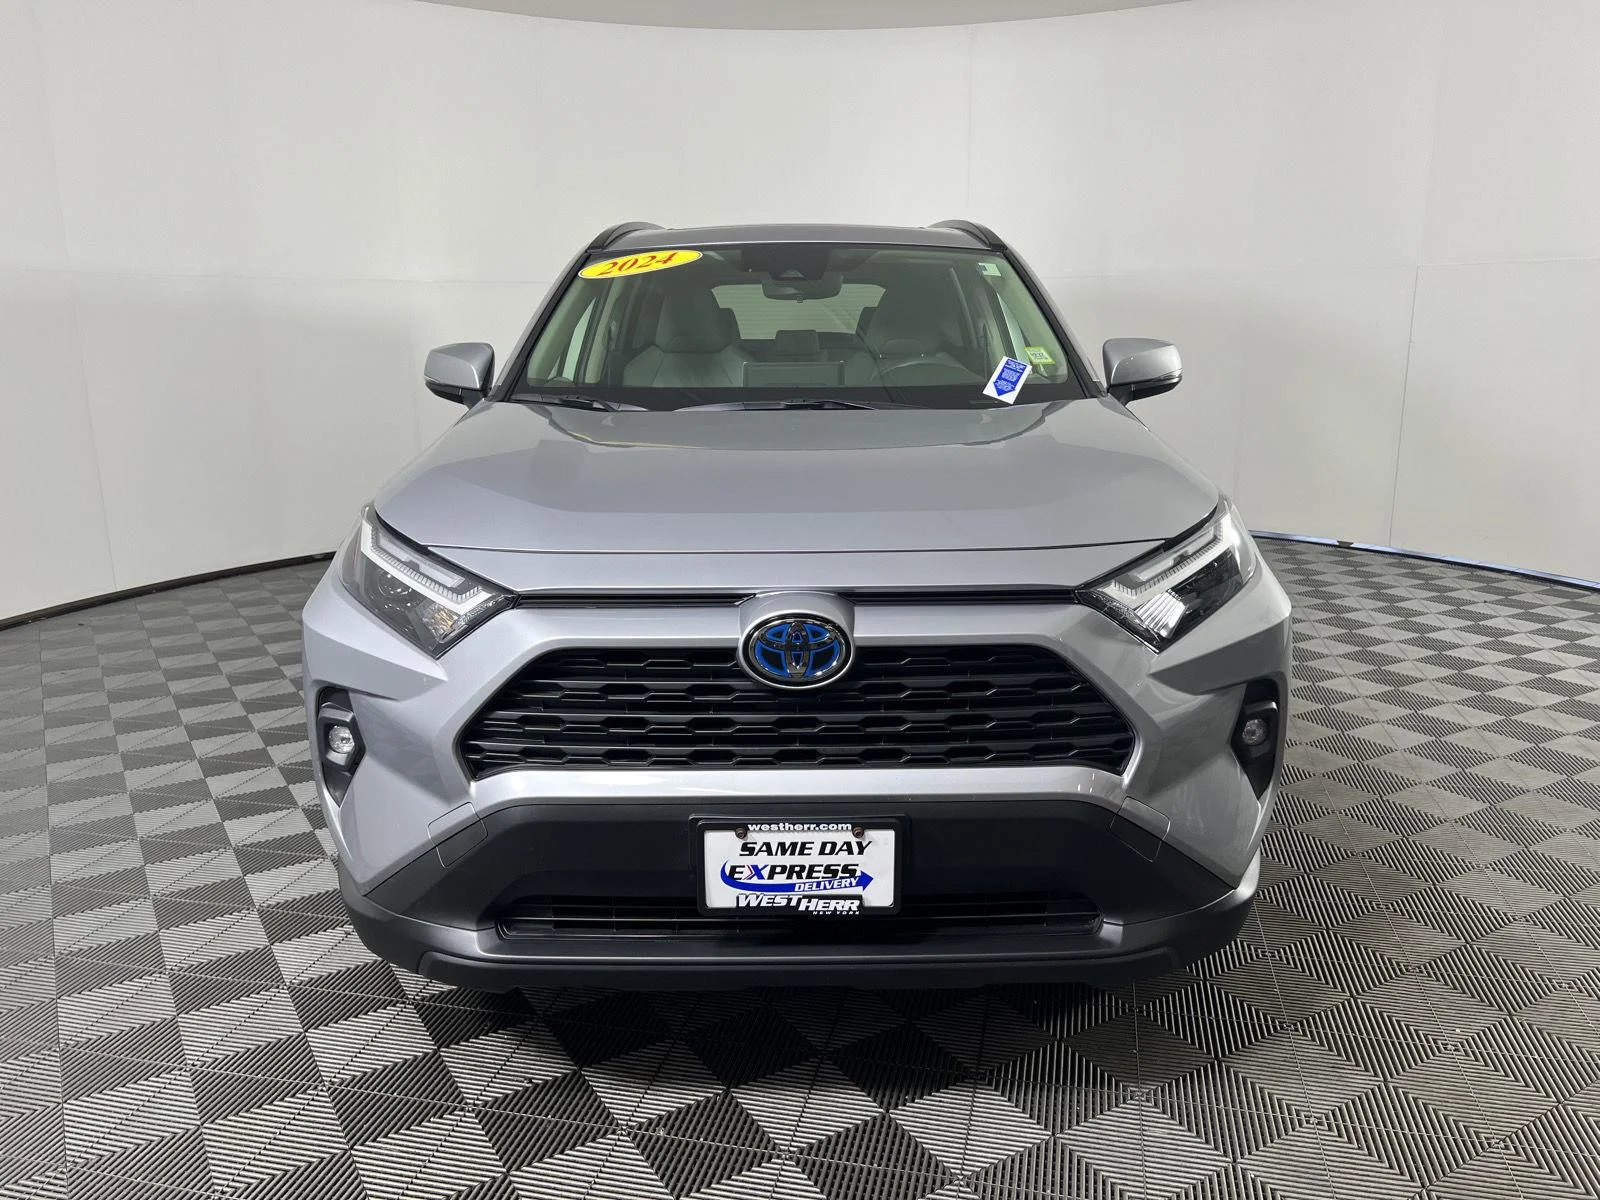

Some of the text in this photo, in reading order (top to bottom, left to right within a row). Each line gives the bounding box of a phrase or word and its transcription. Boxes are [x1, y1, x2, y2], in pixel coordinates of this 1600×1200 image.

[596, 252, 678, 276] 2024
[747, 822, 852, 831] westherr.com
[739, 840, 873, 857] SAME DAY
[728, 863, 859, 881] EXPRESS
[794, 877, 859, 892] DELIVERY
